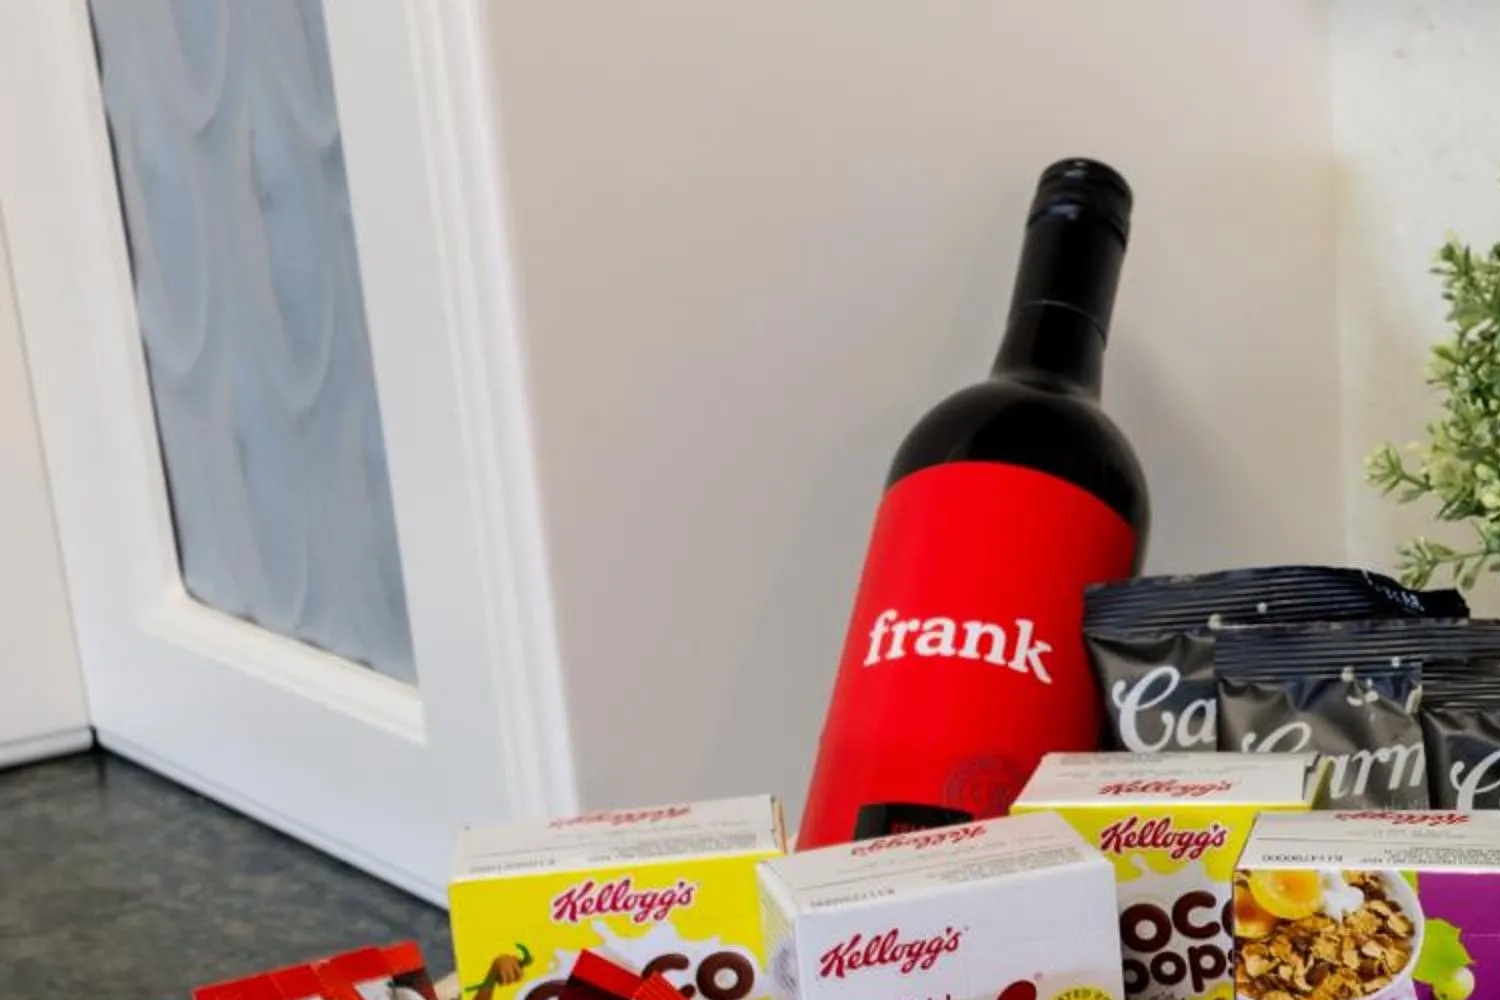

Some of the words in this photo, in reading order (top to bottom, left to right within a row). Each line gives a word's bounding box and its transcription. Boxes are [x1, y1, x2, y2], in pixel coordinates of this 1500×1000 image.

[863, 608, 1053, 685] frank
[1112, 666, 1217, 753] Ca
[1100, 815, 1228, 860] Kellogg's
[552, 878, 696, 924] Kellogg's
[819, 926, 963, 979] Kellogg's
